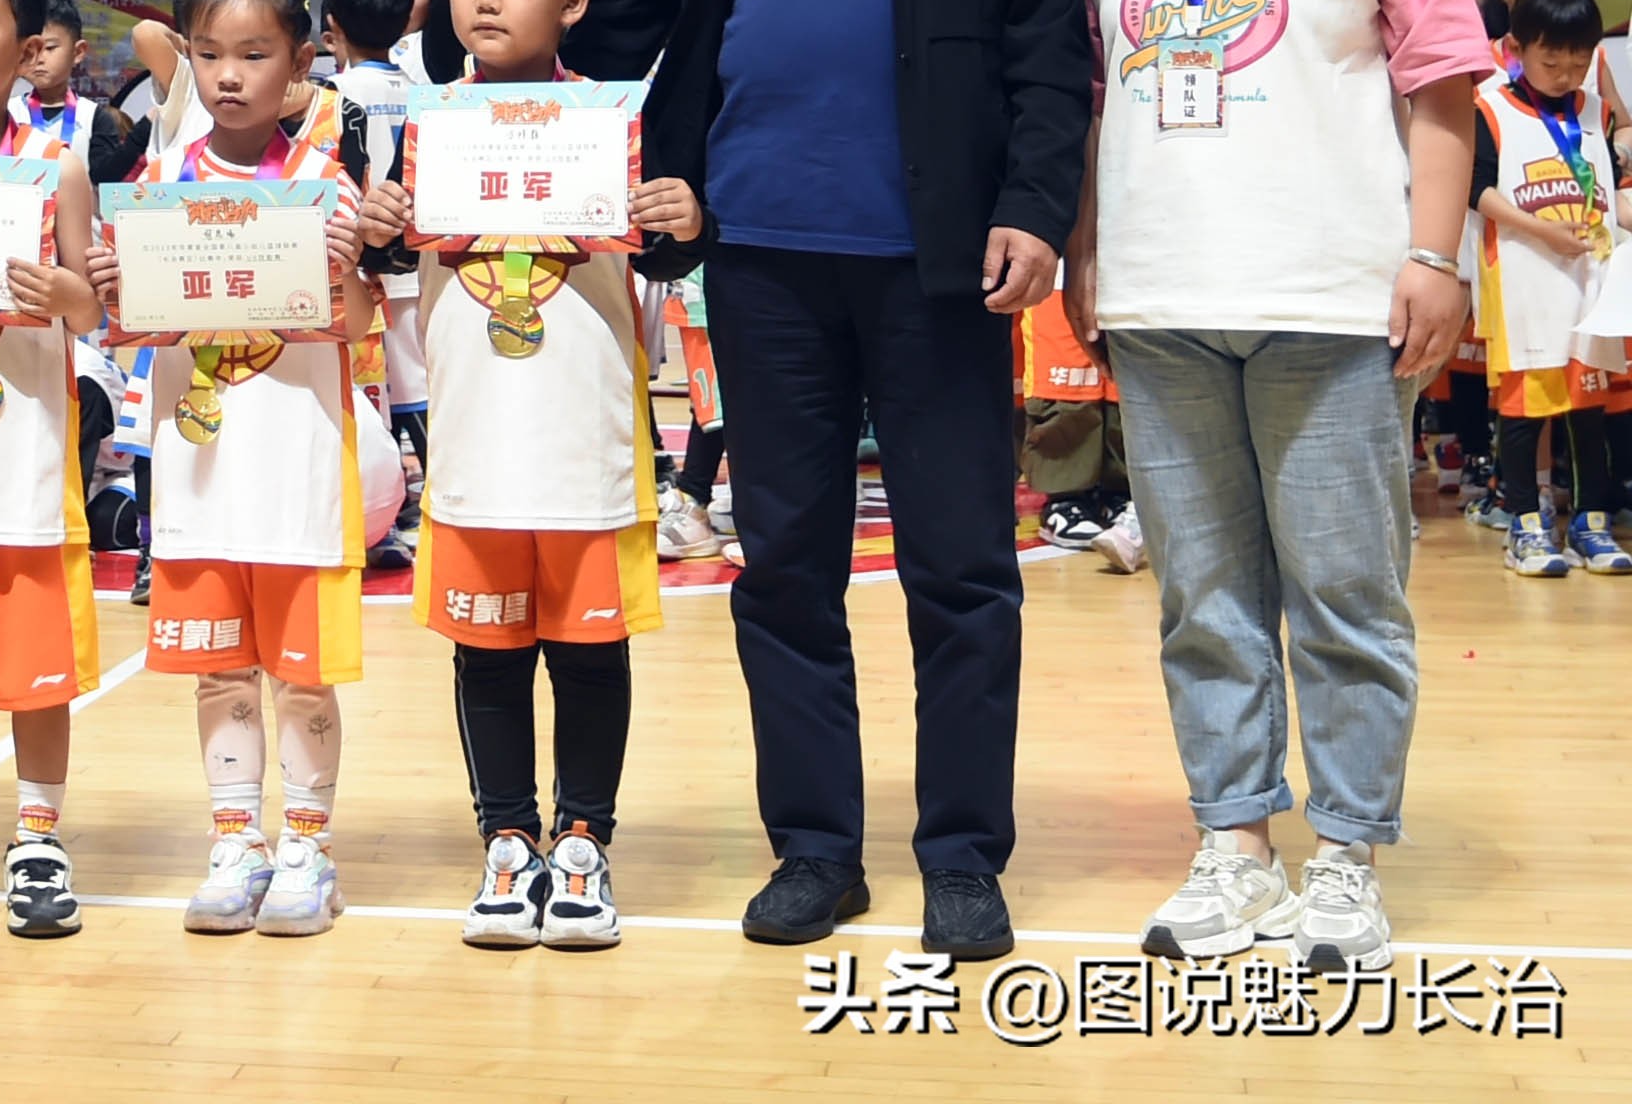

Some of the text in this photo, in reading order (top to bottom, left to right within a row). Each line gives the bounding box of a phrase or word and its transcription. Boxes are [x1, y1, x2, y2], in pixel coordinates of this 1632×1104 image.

[1183, 73, 1197, 118] 领队证
[480, 171, 553, 202] 亚军
[182, 269, 256, 300] 亚军
[445, 589, 528, 626] 华蒙星
[152, 617, 243, 652] 华蒙星
